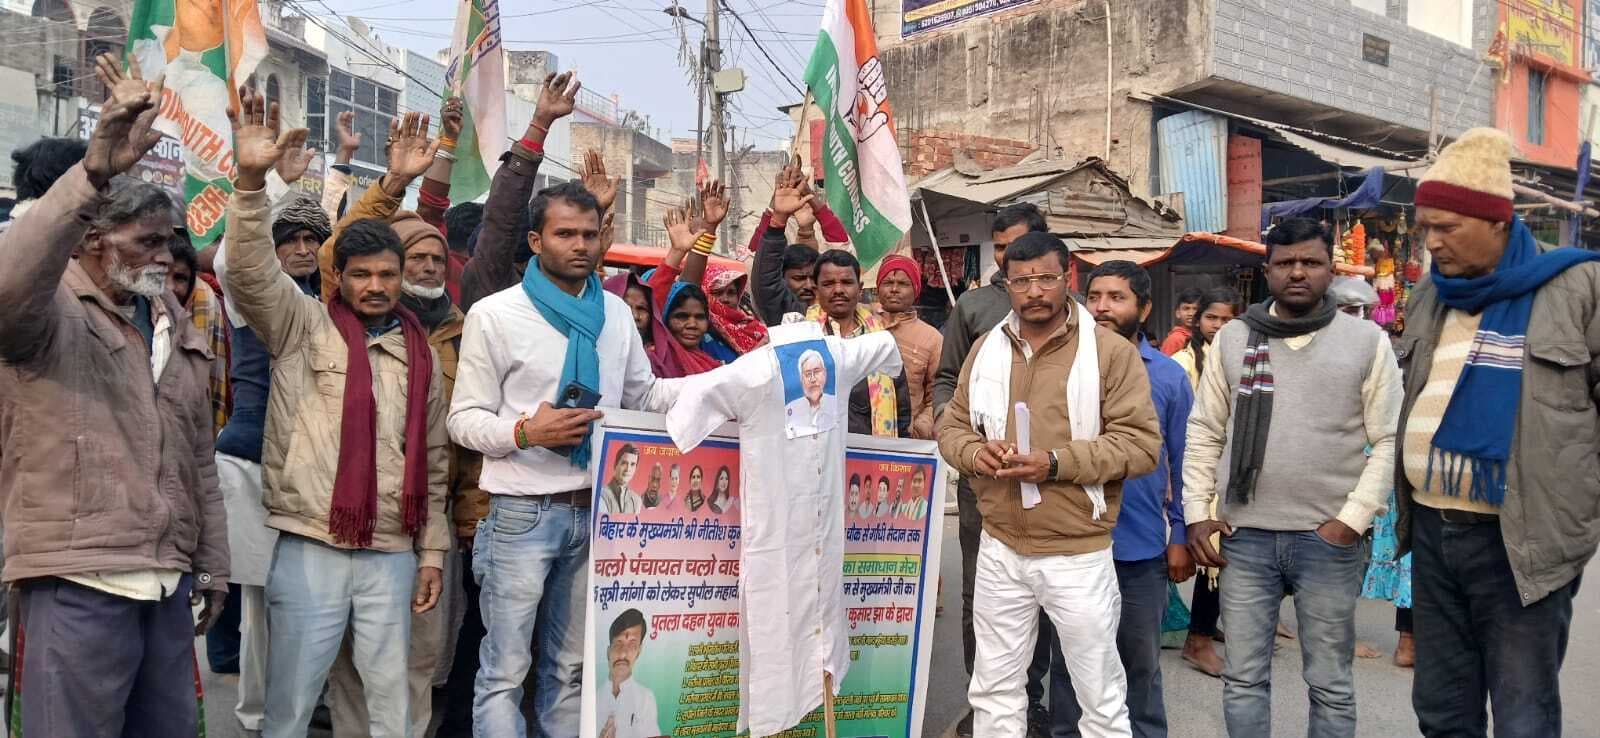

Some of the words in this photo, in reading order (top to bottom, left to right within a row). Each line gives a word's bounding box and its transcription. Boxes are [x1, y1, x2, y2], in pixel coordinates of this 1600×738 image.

[599, 515, 626, 540] बिहार
[626, 516, 639, 539] के
[639, 516, 684, 548] मुख्यमंत्री
[684, 517, 698, 541] श्री
[697, 519, 728, 541] नीतीश
[595, 552, 627, 577] चलो
[630, 552, 683, 577] पंचायत
[685, 553, 717, 577] चलो
[599, 580, 620, 610] सूत्री
[645, 580, 661, 601] को
[661, 581, 685, 602] लेकर
[650, 612, 682, 640] पुतला
[682, 612, 706, 632] दहन
[707, 612, 727, 638] युवा
[848, 606, 873, 630] कुमार
